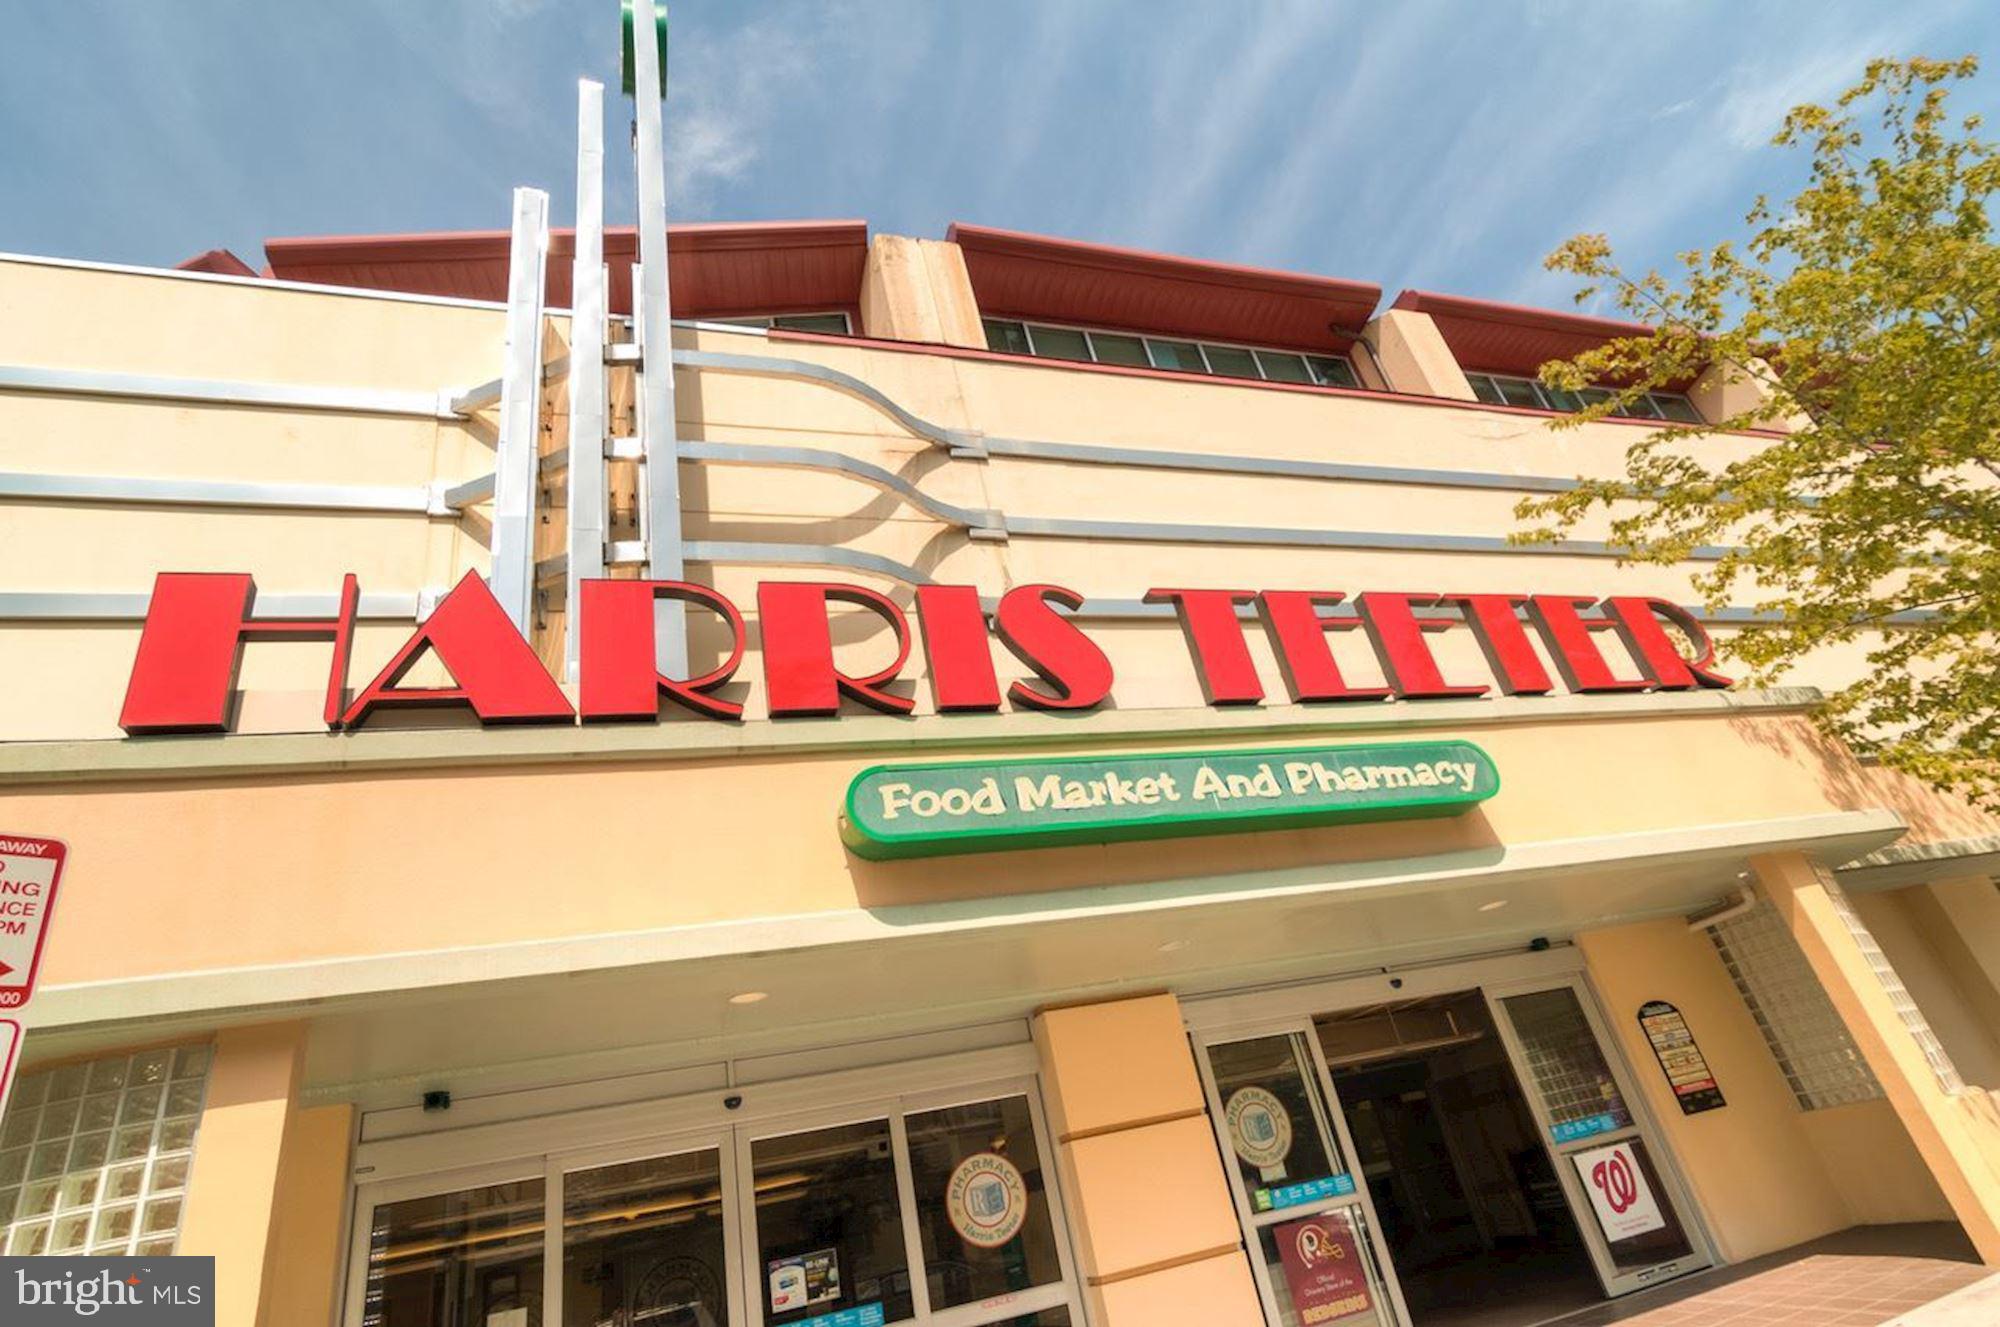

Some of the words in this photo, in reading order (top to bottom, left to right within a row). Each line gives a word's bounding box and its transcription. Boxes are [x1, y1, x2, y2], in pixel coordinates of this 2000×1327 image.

[119, 567, 1115, 736] HARRIS
[1142, 588, 1735, 706] TEETER
[878, 783, 1007, 820] Food
[1014, 771, 1182, 813] Market
[1191, 763, 1283, 801] And
[1284, 760, 1477, 794] Pharmacy
[952, 1158, 1020, 1201] PHARMACY
